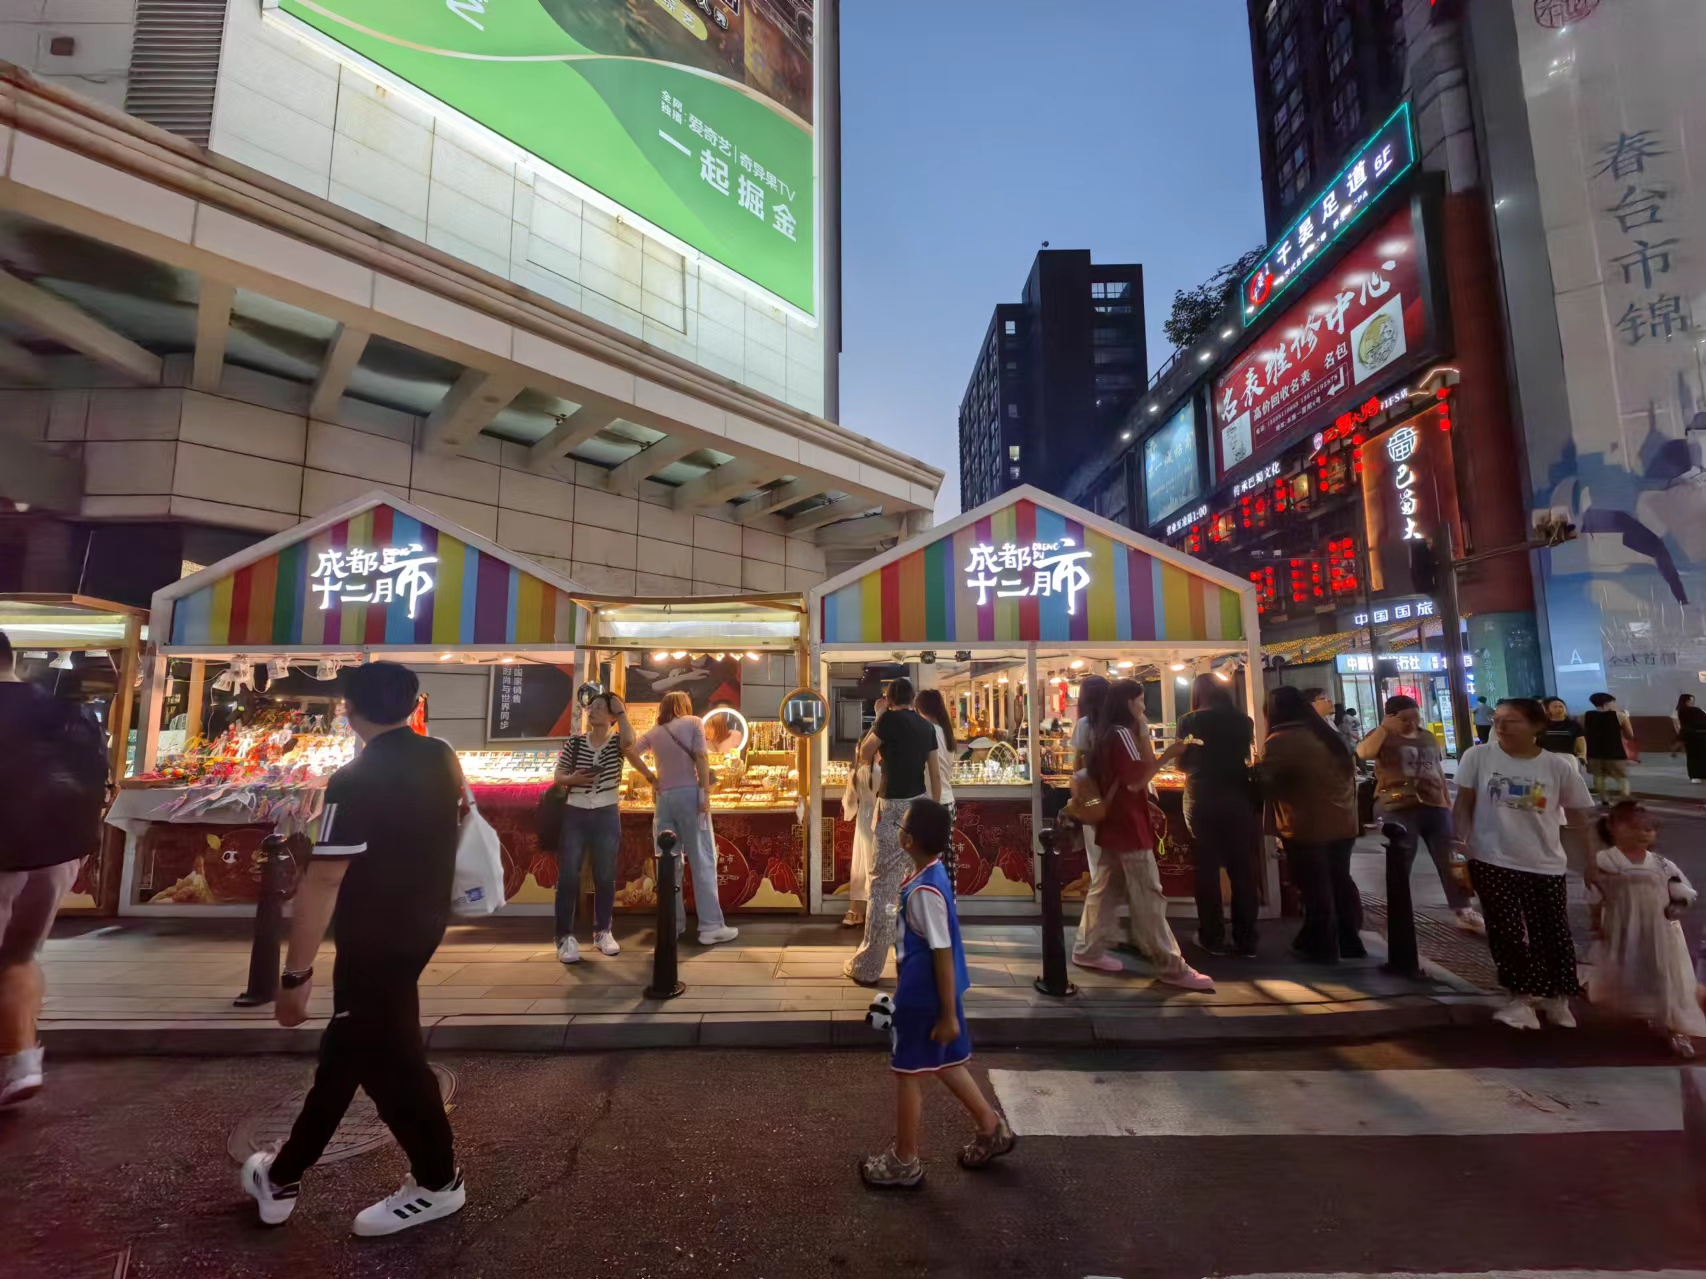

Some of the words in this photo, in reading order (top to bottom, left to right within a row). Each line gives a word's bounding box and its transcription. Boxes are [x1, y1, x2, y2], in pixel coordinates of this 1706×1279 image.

[661, 91, 683, 113] 全网
[689, 113, 731, 157] 爱奇艺
[740, 152, 796, 202] 奇异果TV
[1375, 144, 1391, 171] 6F
[659, 128, 797, 242] 一起掘金
[1221, 260, 1396, 422] 名表维修中心
[1253, 369, 1311, 421] 高价回收名表
[1324, 342, 1348, 369] 名包
[310, 547, 379, 579] 成都
[964, 542, 1032, 574] 成都
[1354, 601, 1434, 626] 中国国旅
